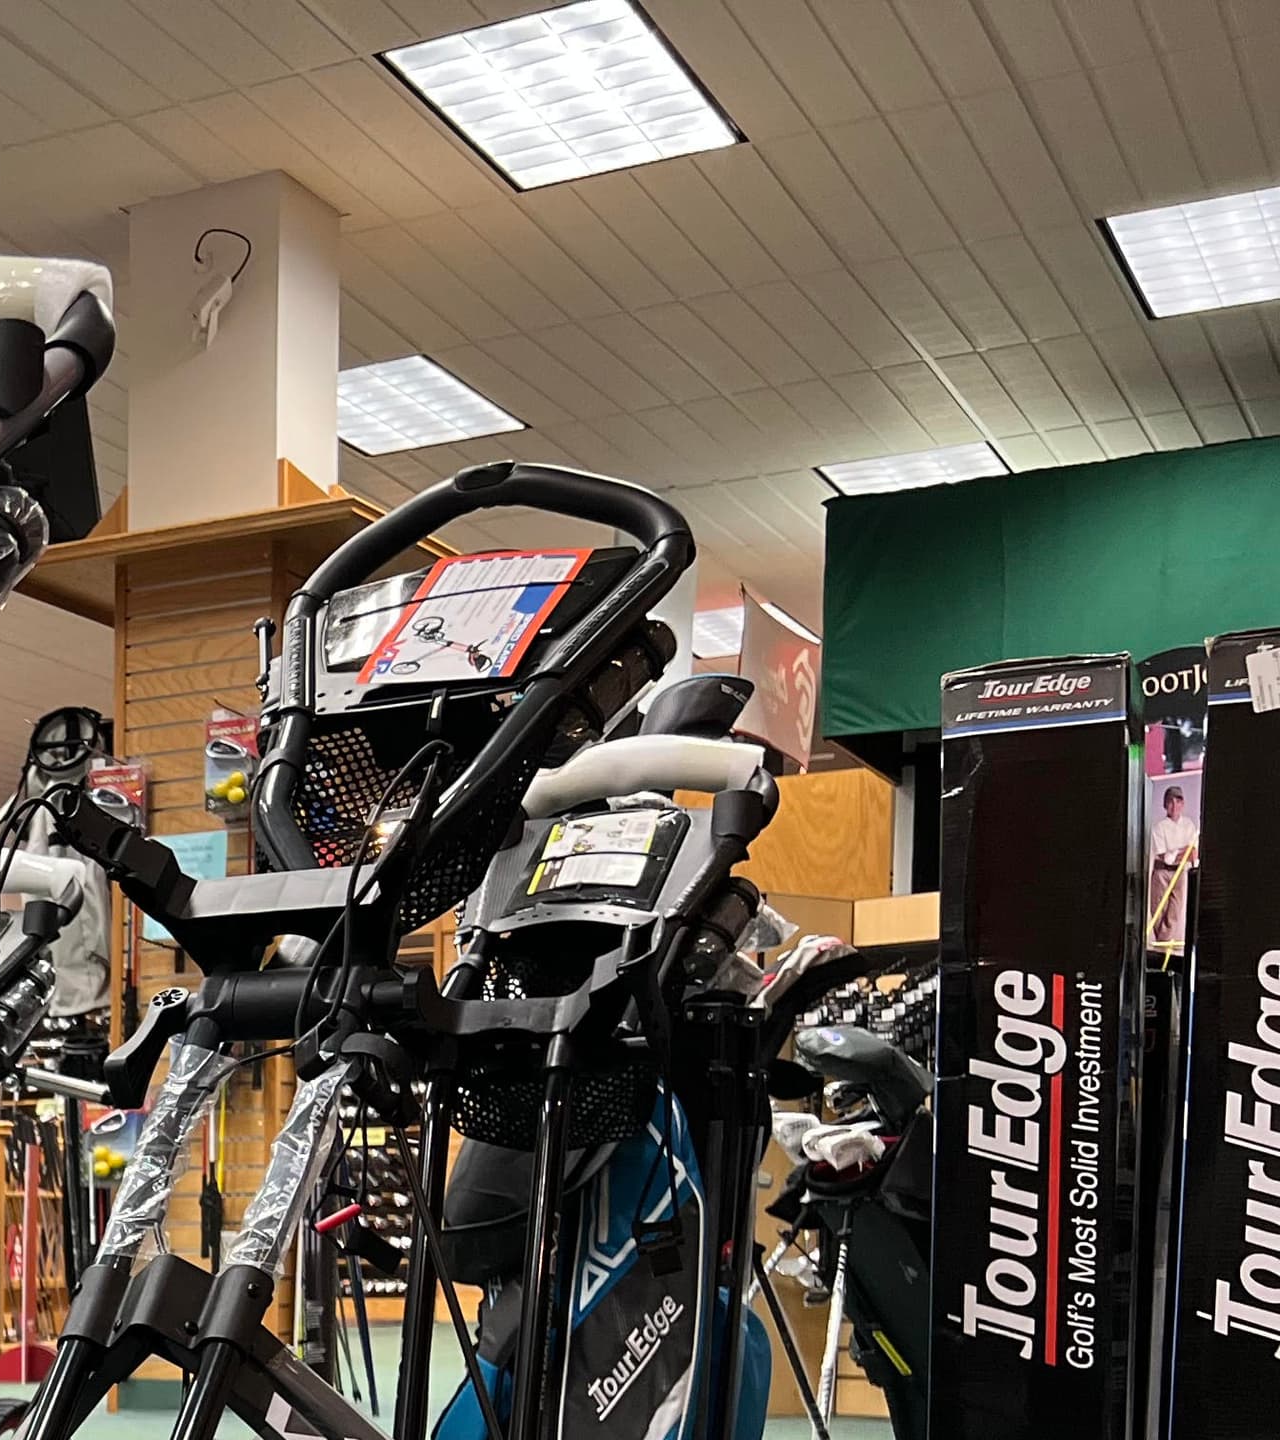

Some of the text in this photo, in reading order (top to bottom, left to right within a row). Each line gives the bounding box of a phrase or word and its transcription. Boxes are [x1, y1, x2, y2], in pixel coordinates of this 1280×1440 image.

[955, 697, 1114, 723] LIFETIME WARRANTY
[1065, 980, 1103, 1369] Golf's Most Solid Investment
